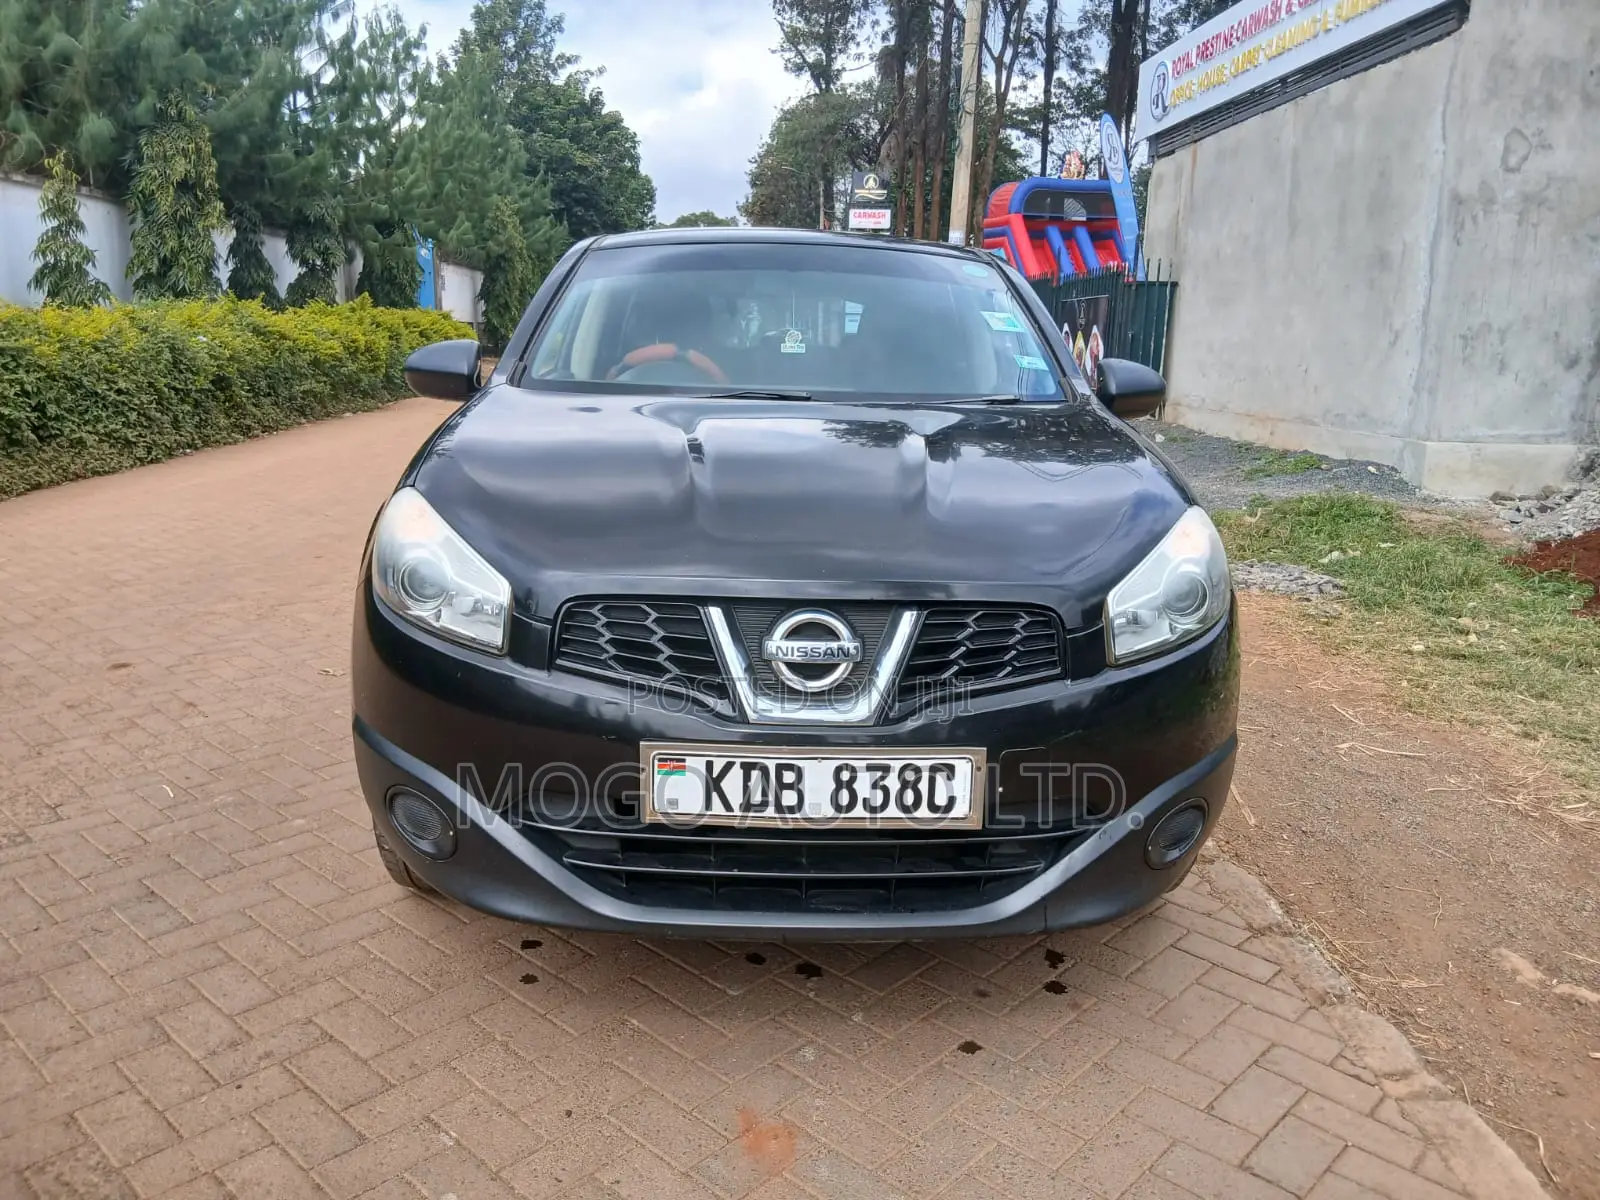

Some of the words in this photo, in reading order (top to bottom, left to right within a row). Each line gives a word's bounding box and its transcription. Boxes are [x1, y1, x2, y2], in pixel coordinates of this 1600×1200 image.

[1172, 49, 1195, 78] ROYAL
[1196, 24, 1234, 62] PRESTINE
[853, 211, 886, 219] CARWASH
[775, 645, 850, 659] NISSAN
[705, 760, 804, 815] KDB
[831, 762, 956, 815] 838C
